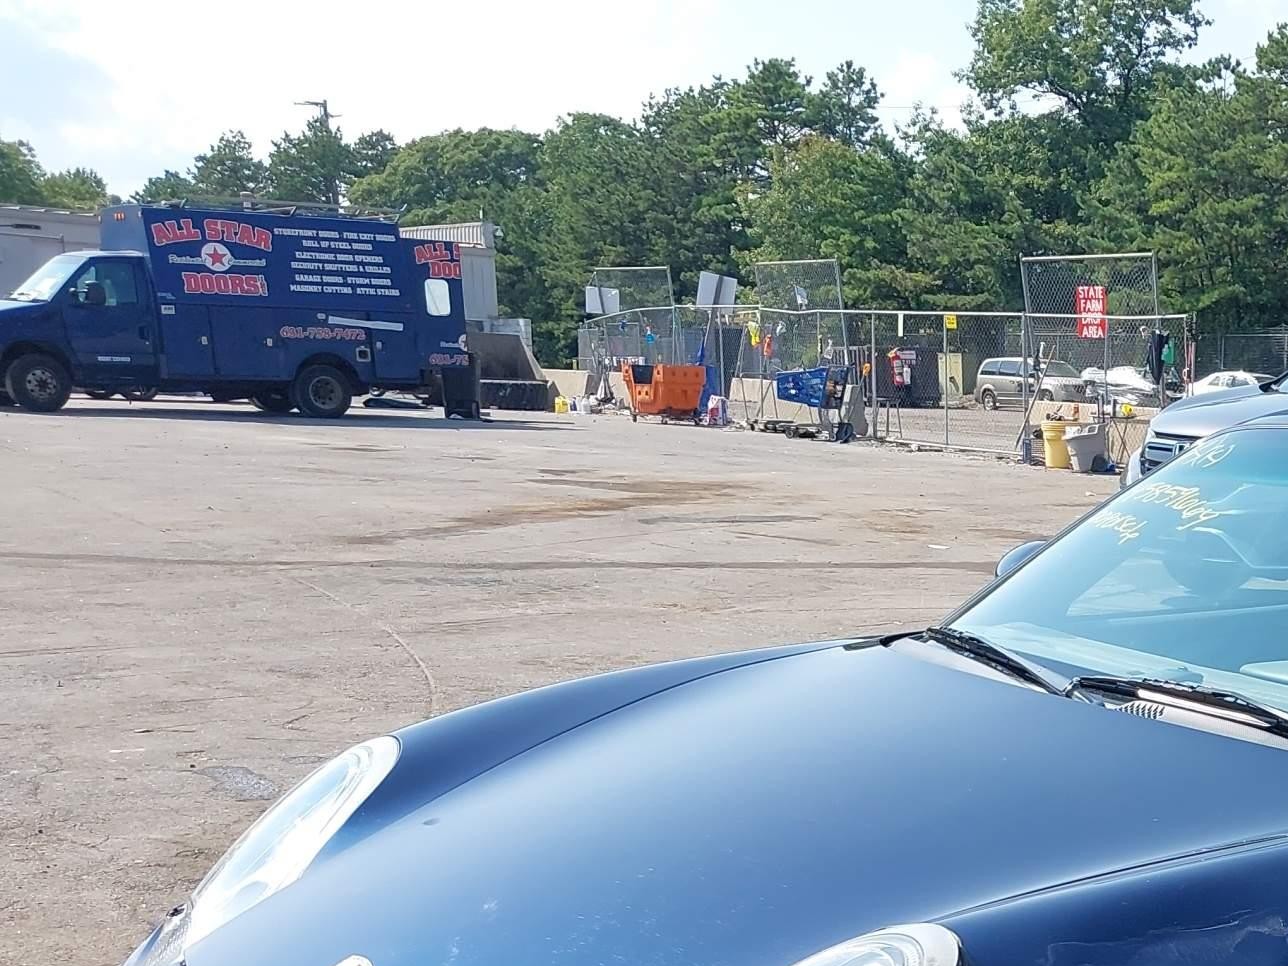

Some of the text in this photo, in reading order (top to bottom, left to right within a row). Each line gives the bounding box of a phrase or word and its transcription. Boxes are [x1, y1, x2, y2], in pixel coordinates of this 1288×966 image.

[151, 218, 272, 252] ALL STAR
[273, 228, 317, 237] STOREFRONT
[331, 241, 351, 249] STEEL
[295, 251, 336, 260] ELECTRONIC
[354, 255, 384, 263] OPENERS
[414, 242, 450, 264] ALL
[291, 262, 323, 270] SECURITY
[182, 272, 261, 296] DOORS
[295, 274, 322, 282] GARAGE
[290, 284, 400, 296] MASONRY CUTTING ATTIC STAIRS
[1078, 285, 1104, 299] STATE
[1080, 299, 1103, 312] FARM
[1081, 312, 1103, 324] DROP
[1082, 325, 1104, 338] AREA
